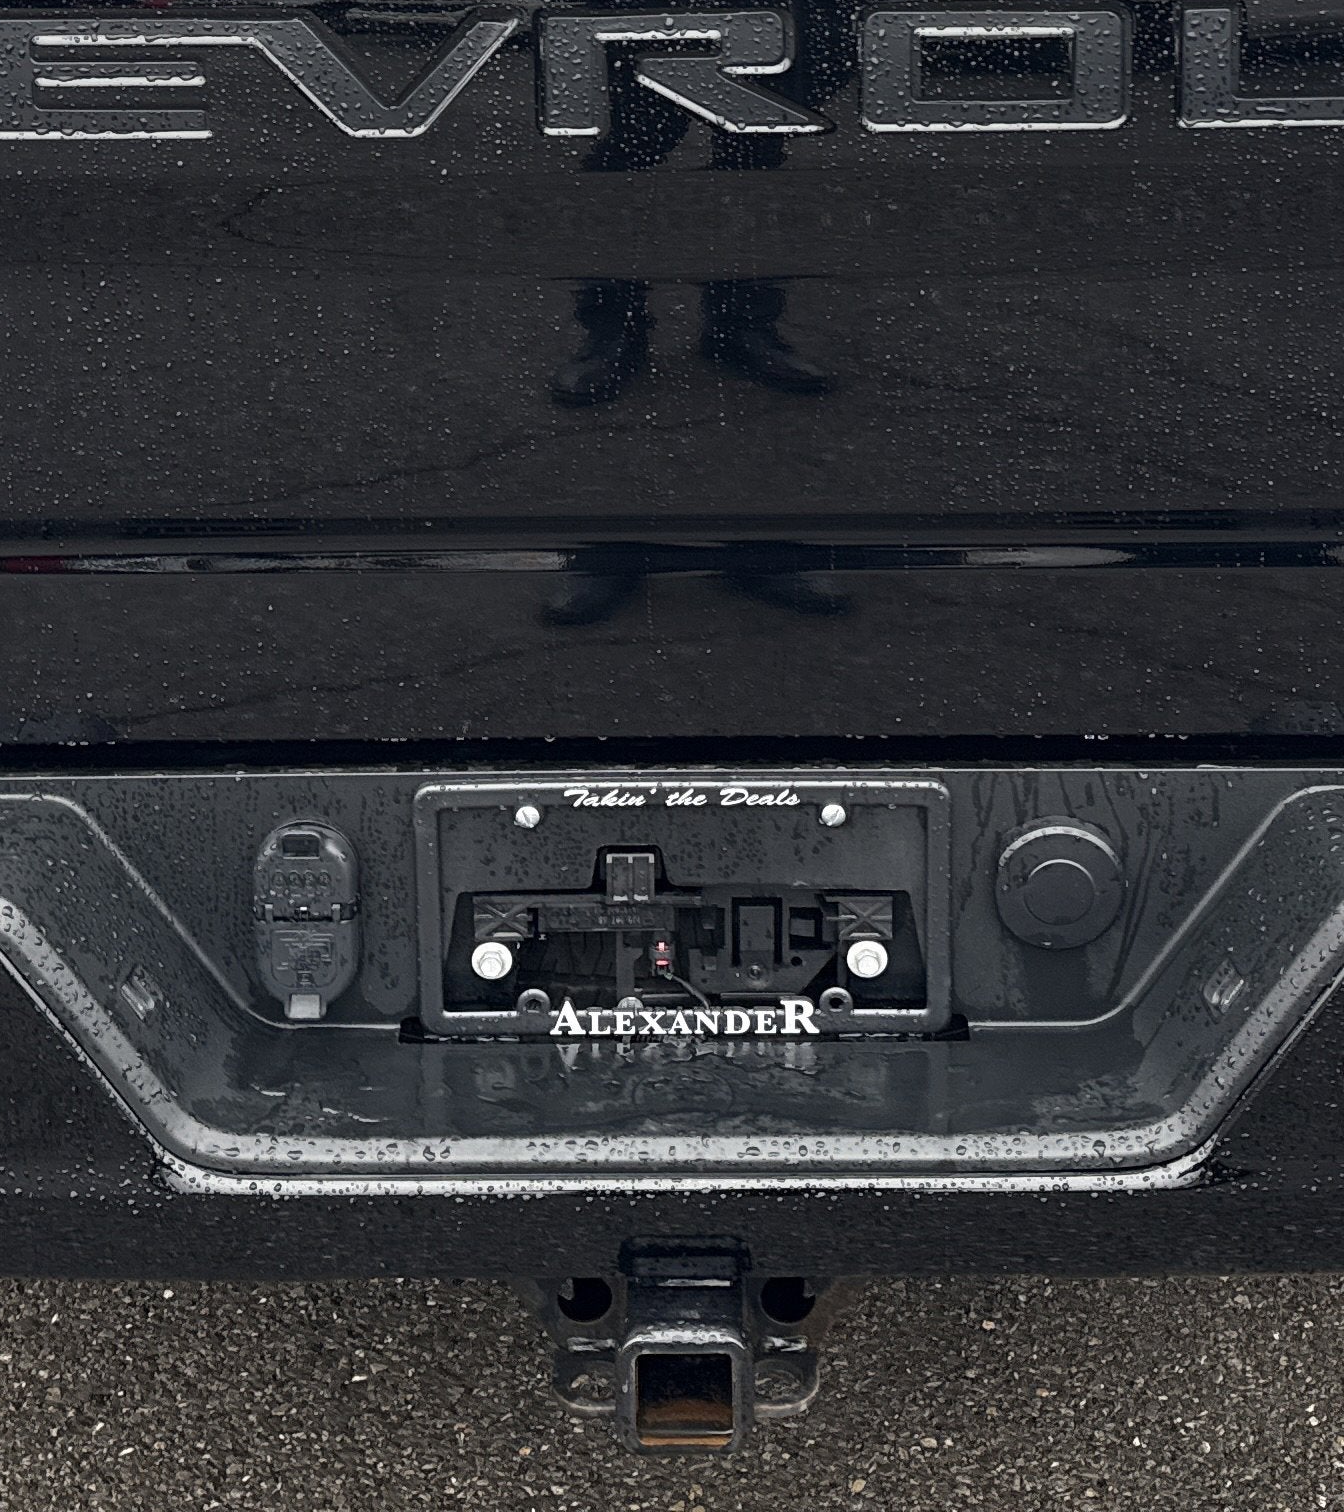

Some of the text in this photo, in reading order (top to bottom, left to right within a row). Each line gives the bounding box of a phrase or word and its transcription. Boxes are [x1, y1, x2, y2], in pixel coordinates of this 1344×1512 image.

[563, 787, 801, 808] Takin' the Deals
[550, 999, 820, 1036] ALEXANDER
